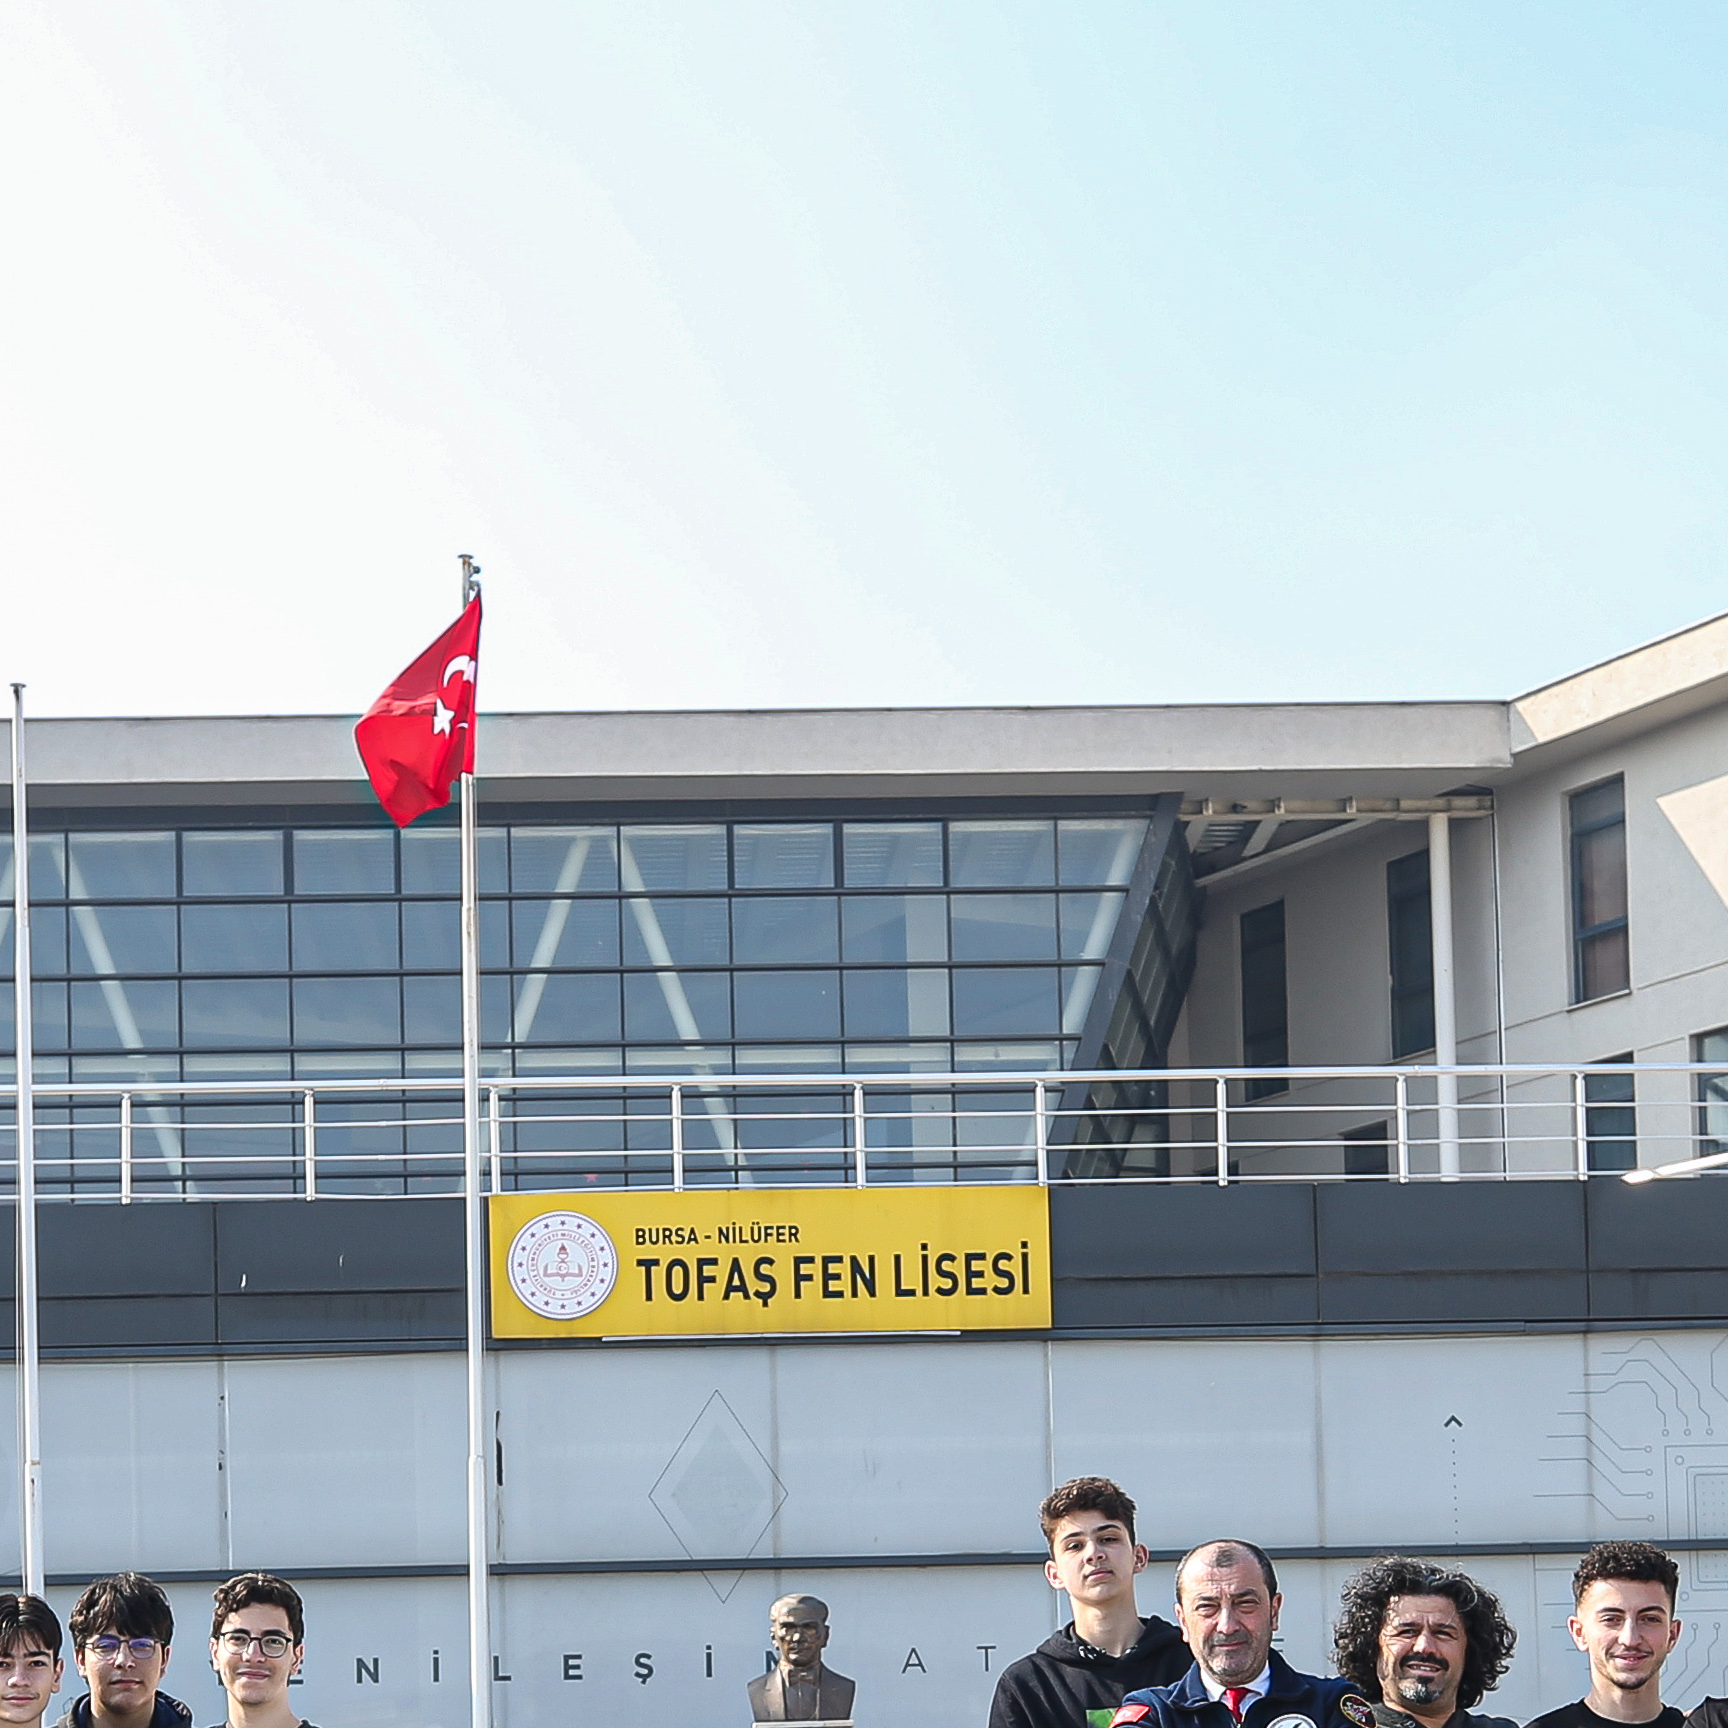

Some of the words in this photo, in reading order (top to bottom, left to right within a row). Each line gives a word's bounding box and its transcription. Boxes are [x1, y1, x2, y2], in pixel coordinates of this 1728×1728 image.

[634, 1227, 699, 1245] BURSA
[717, 1221, 800, 1244] NİLÜFER
[636, 1255, 777, 1307] TOFAŞ
[793, 1253, 877, 1299] FEN
[894, 1240, 1032, 1297] LİSESİ
